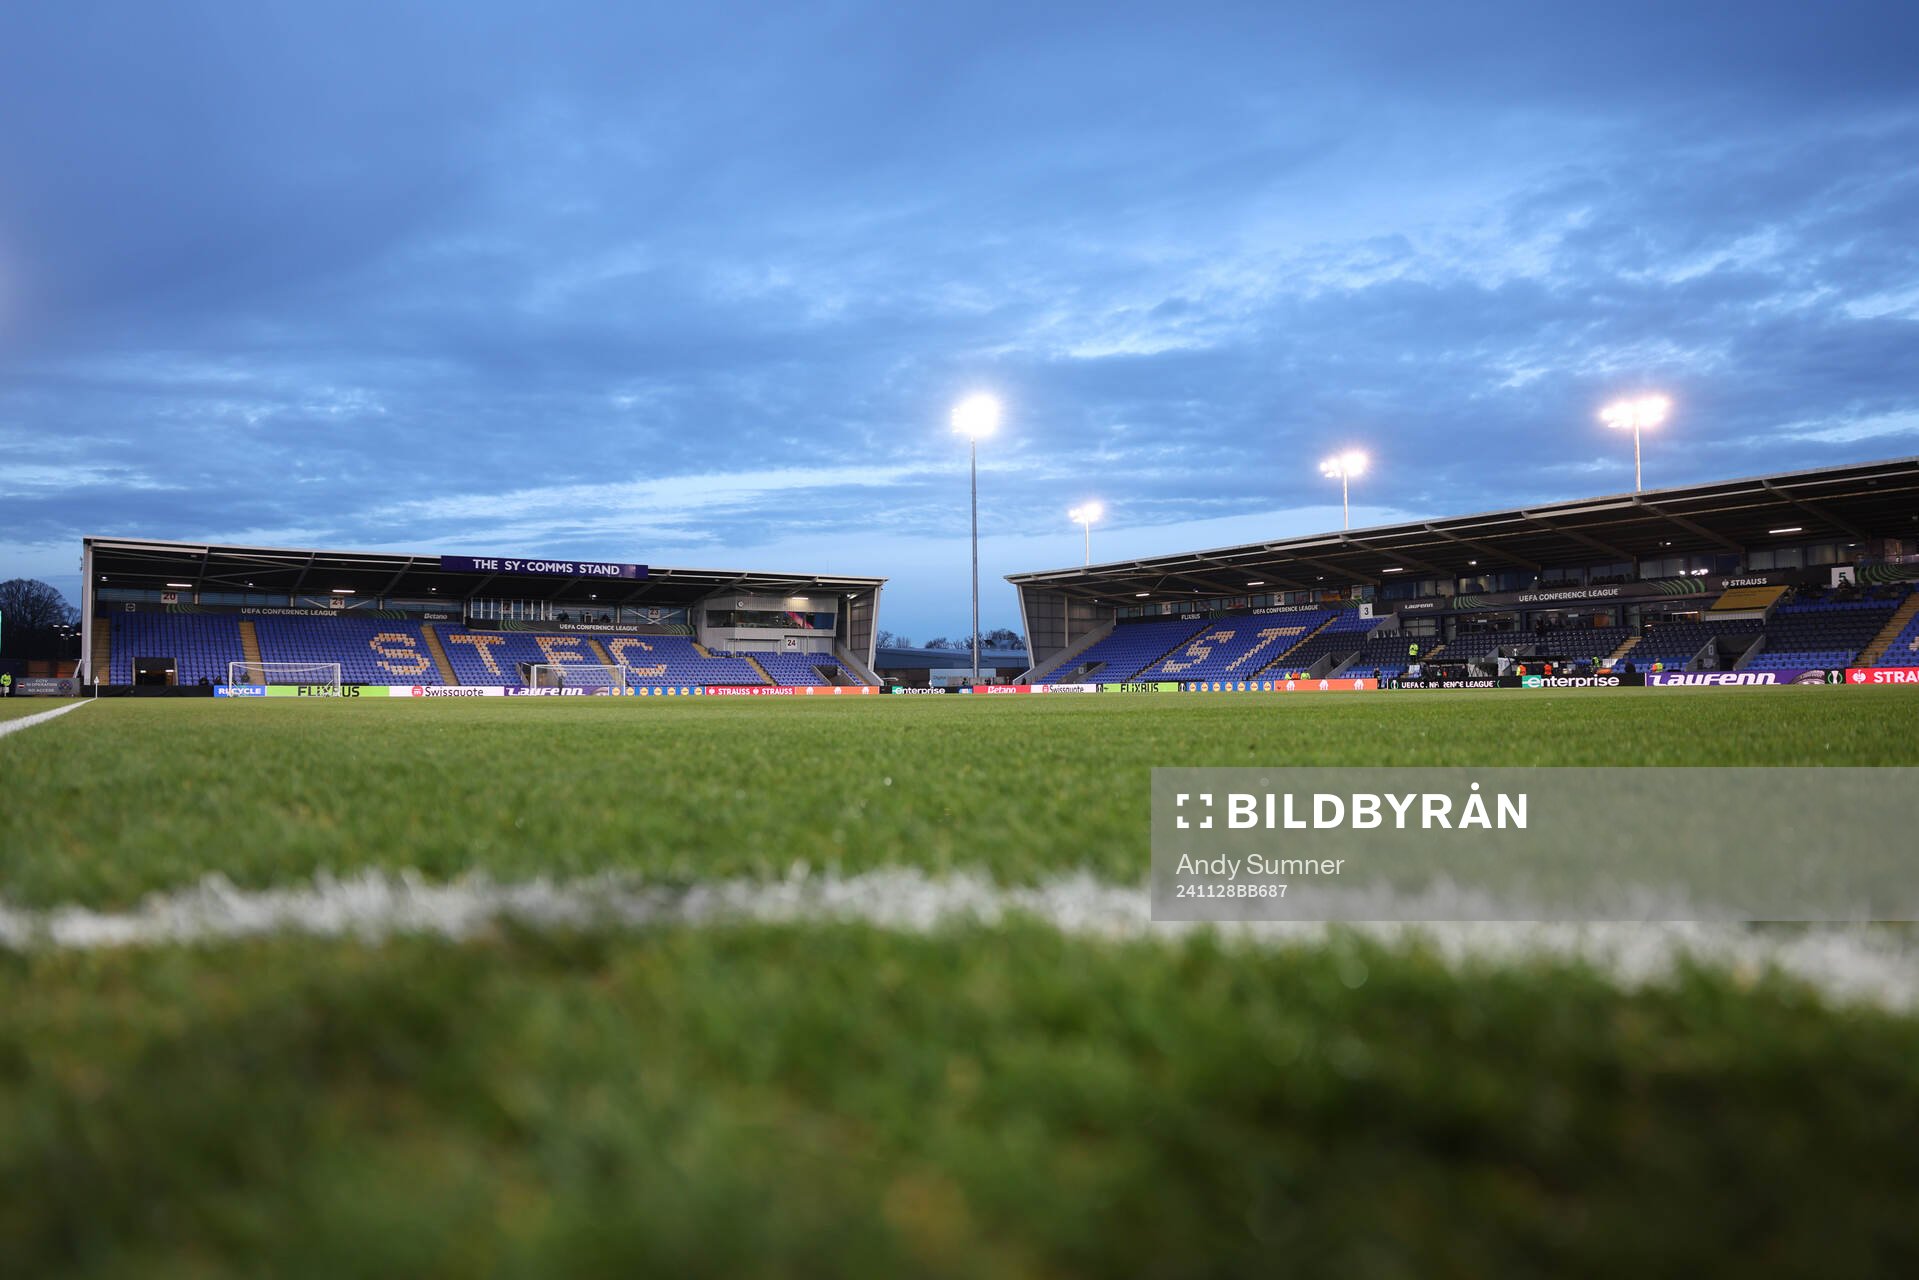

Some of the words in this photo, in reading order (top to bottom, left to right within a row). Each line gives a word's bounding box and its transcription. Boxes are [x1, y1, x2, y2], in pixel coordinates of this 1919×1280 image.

[473, 559, 498, 570] THE
[579, 564, 620, 575] STAND
[1730, 577, 1767, 586] STRAUSS
[163, 592, 176, 600] 20
[1539, 591, 1587, 601] CONFERENCE
[1589, 588, 1619, 597] LEAGUE
[1266, 606, 1298, 614] CONFERENCE
[1364, 607, 1369, 615] 3
[787, 639, 796, 647] 24
[1465, 680, 1494, 688] LEAGUE
[1527, 674, 1620, 688] enterprise
[718, 687, 750, 695] STRAUSS
[762, 687, 793, 695] STRAUSS
[895, 686, 945, 694] enterprise
